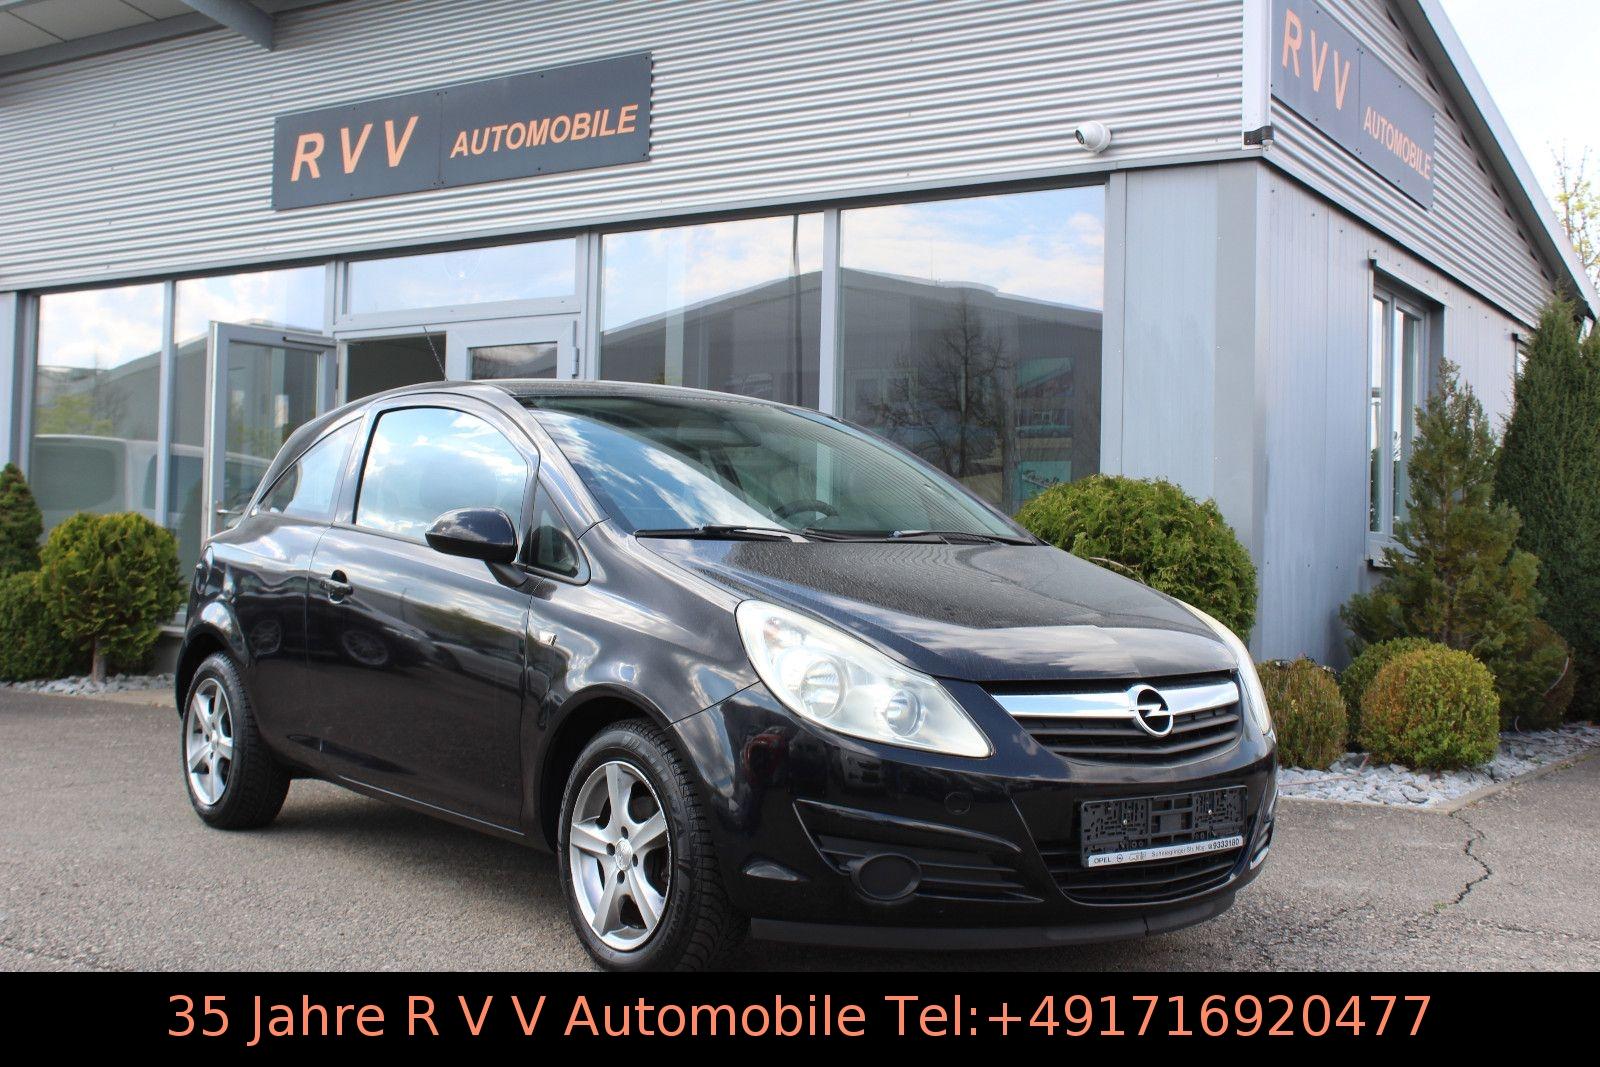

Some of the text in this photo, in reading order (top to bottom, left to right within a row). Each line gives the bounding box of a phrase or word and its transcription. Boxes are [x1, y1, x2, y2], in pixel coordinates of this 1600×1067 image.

[450, 104, 638, 159] AUTOMOBILE
[1364, 106, 1432, 180] AUTOMOBILE
[1093, 856, 1111, 864] OPEL
